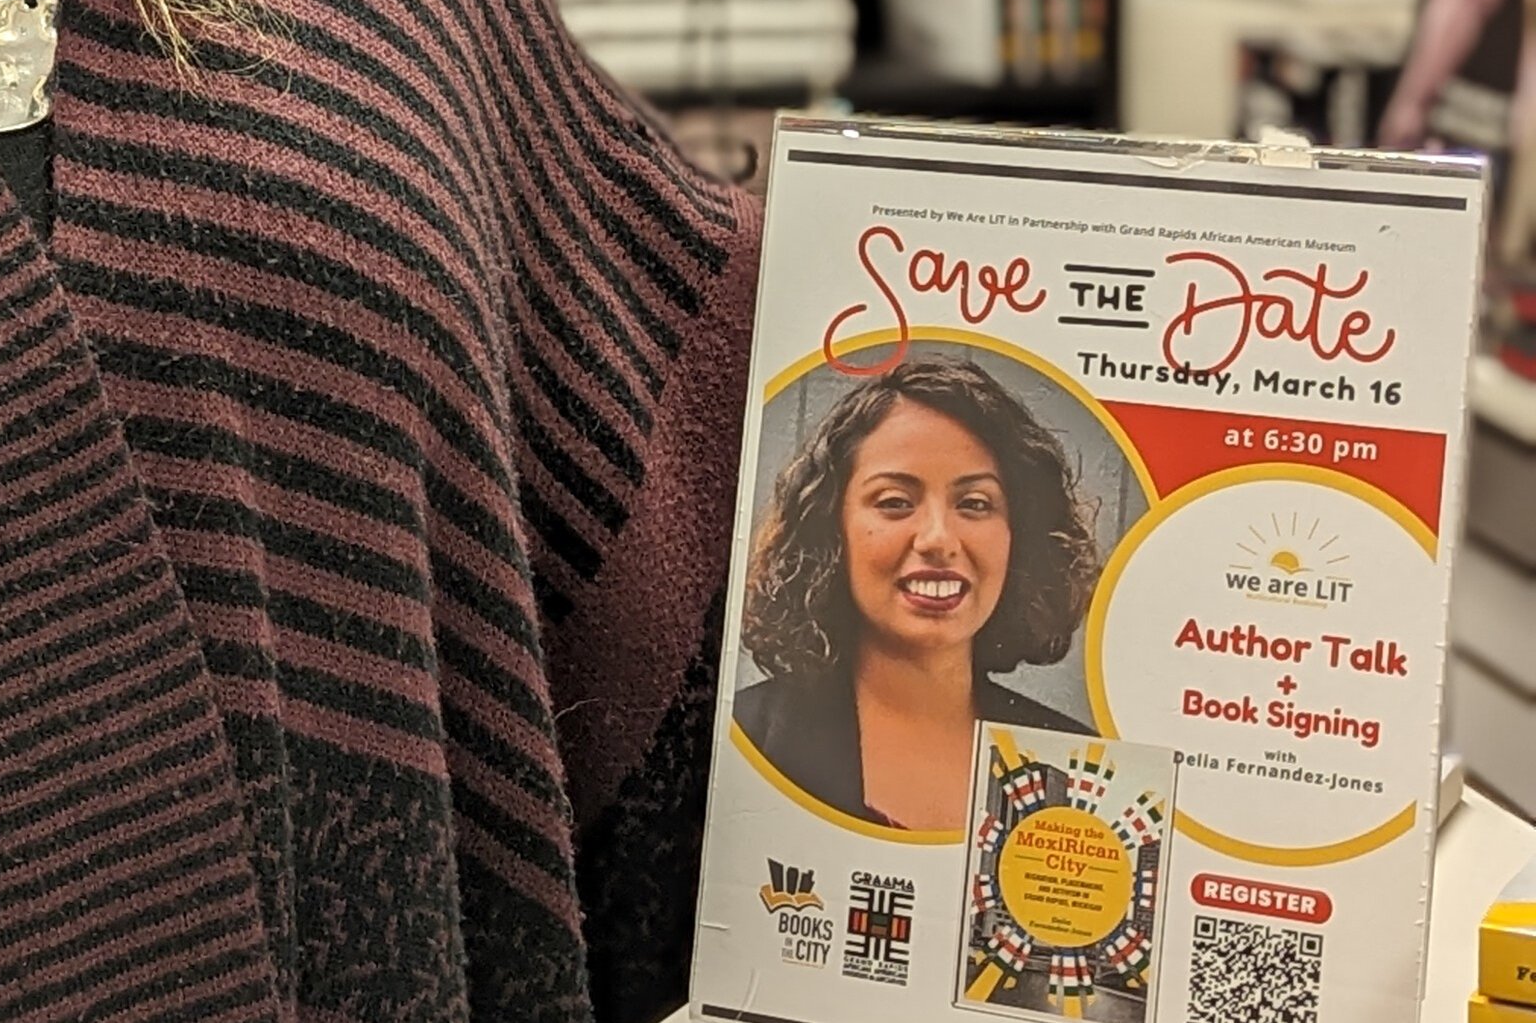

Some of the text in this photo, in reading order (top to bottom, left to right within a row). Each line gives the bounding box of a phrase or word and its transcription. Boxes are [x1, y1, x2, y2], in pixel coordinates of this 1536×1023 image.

[872, 205, 927, 219] Presented
[930, 210, 943, 222] by
[947, 211, 963, 222] We
[966, 213, 985, 224] Are
[1008, 217, 1019, 226] in
[1023, 217, 1089, 233] Partnership
[1092, 223, 1116, 234] with
[1120, 225, 1154, 237] Grand
[1158, 227, 1197, 241] Rapids
[1200, 231, 1242, 244] African
[1245, 235, 1302, 249] American
[1305, 239, 1357, 253] Museum
[824, 225, 1396, 376] Save THE Date
[1077, 351, 1402, 405] Thursday, March 16
[1224, 428, 1378, 463] at 6:30 pm
[1226, 572, 1261, 592] we
[1267, 577, 1308, 598] are
[1315, 579, 1354, 603] LIT
[1174, 618, 1408, 677] Author Talk
[1182, 689, 1380, 748] Book Signing
[1264, 749, 1298, 764] with
[1225, 758, 1384, 794] Fernandez-Jones
[1034, 820, 1082, 839] Making
[851, 870, 915, 893] GRAAMA
[1045, 854, 1088, 877] City
[1203, 879, 1317, 915] REGISTER
[778, 912, 834, 941] BOOKS
[795, 939, 831, 965] CITY
